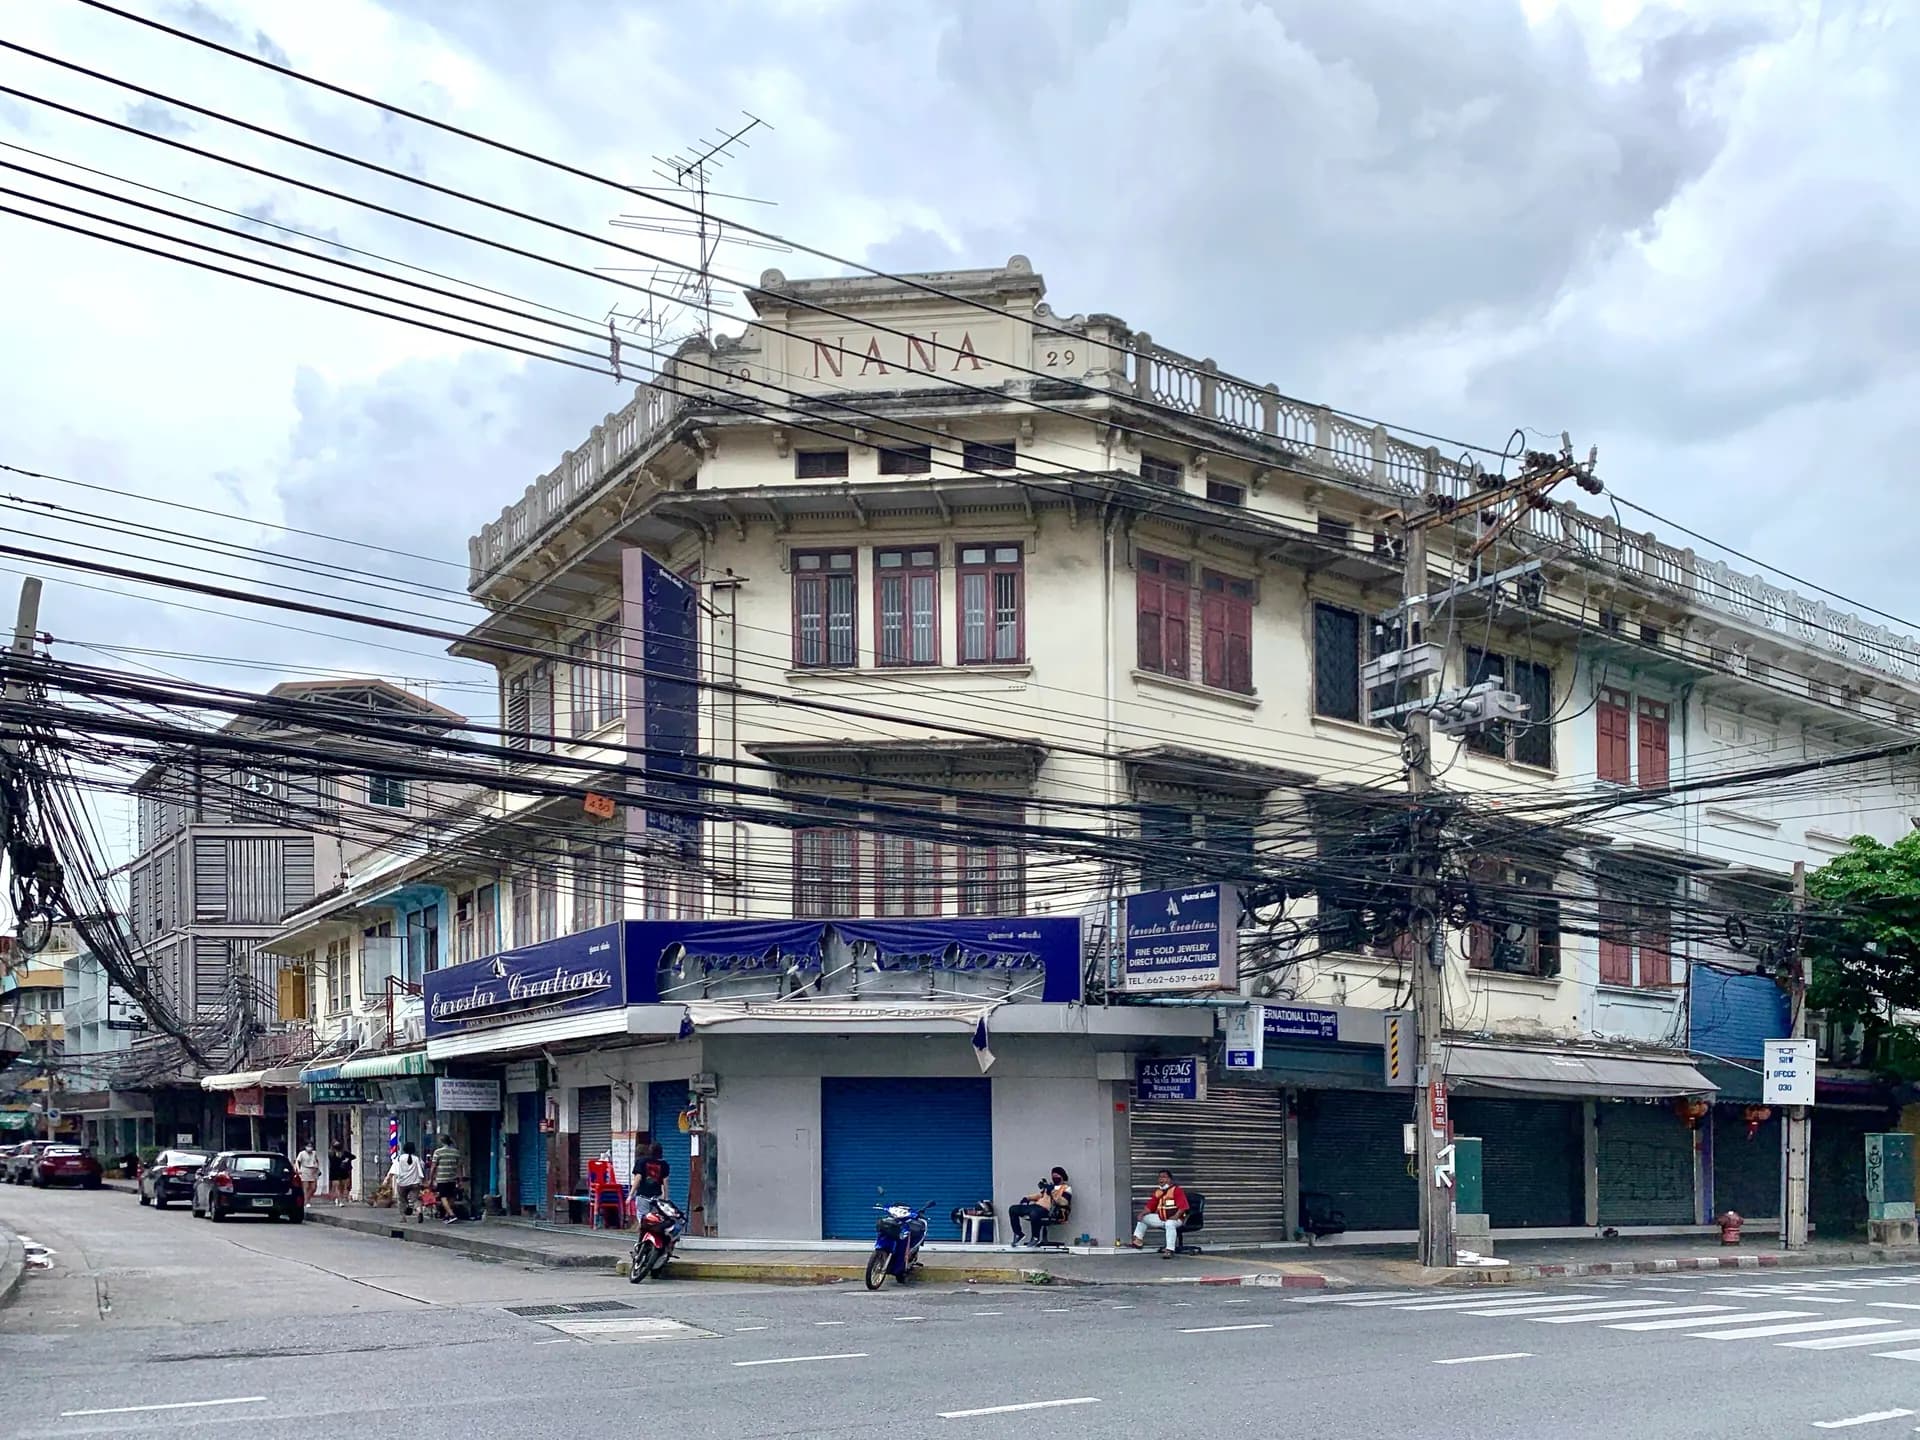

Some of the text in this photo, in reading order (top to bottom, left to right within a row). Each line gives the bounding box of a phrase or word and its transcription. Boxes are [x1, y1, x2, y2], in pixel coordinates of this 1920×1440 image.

[811, 330, 984, 379] NANA
[1046, 349, 1076, 368] 29
[1128, 922, 1166, 937] Eurostar
[1135, 943, 1210, 956] FINE GOLD JEWELRY
[1129, 953, 1217, 967] DIRECT MANUFACTURER
[1128, 973, 1216, 985] TEL. 662-639-6422
[430, 984, 496, 1017] Eurostar
[1233, 1057, 1248, 1065] VISA
[1142, 1062, 1192, 1079] A.S. GEMS
